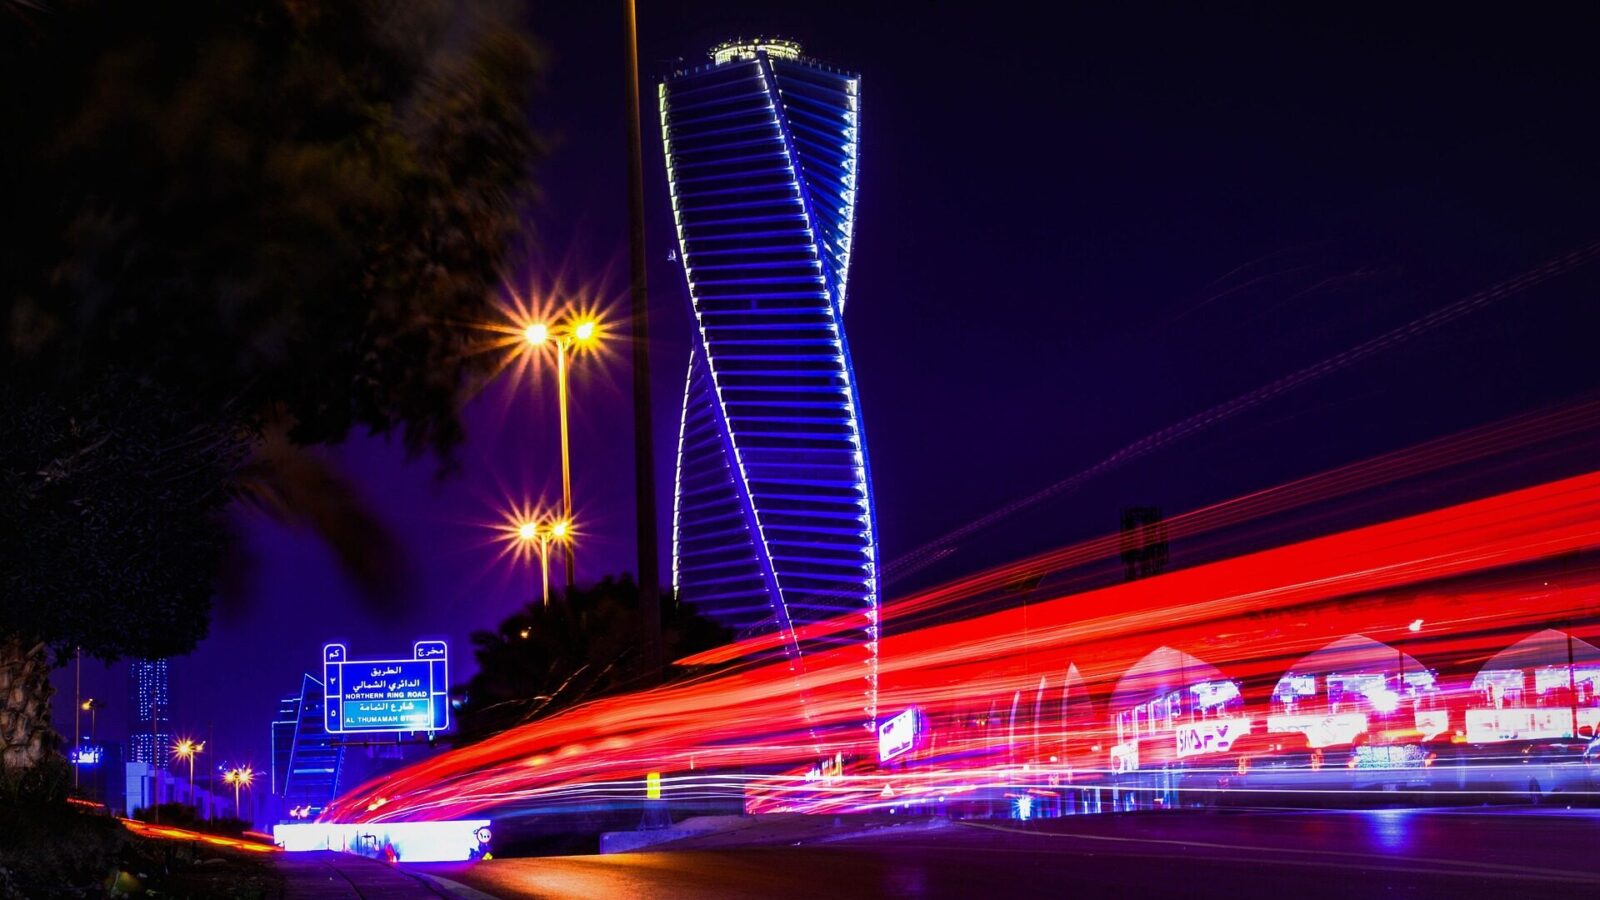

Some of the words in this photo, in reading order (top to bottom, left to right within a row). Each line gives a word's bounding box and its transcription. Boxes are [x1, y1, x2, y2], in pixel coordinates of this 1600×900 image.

[329, 649, 339, 659] كم
[417, 646, 444, 657] مخرج
[370, 665, 402, 677] الطريق
[352, 680, 386, 693] الشمالي
[388, 679, 420, 692] الدائري
[345, 692, 384, 700] NORTHERN
[387, 691, 405, 699] RING
[407, 690, 428, 698] ROAD
[359, 702, 388, 712] الثمامة
[390, 701, 415, 713] شارع
[357, 715, 398, 723] THUMAMAH
